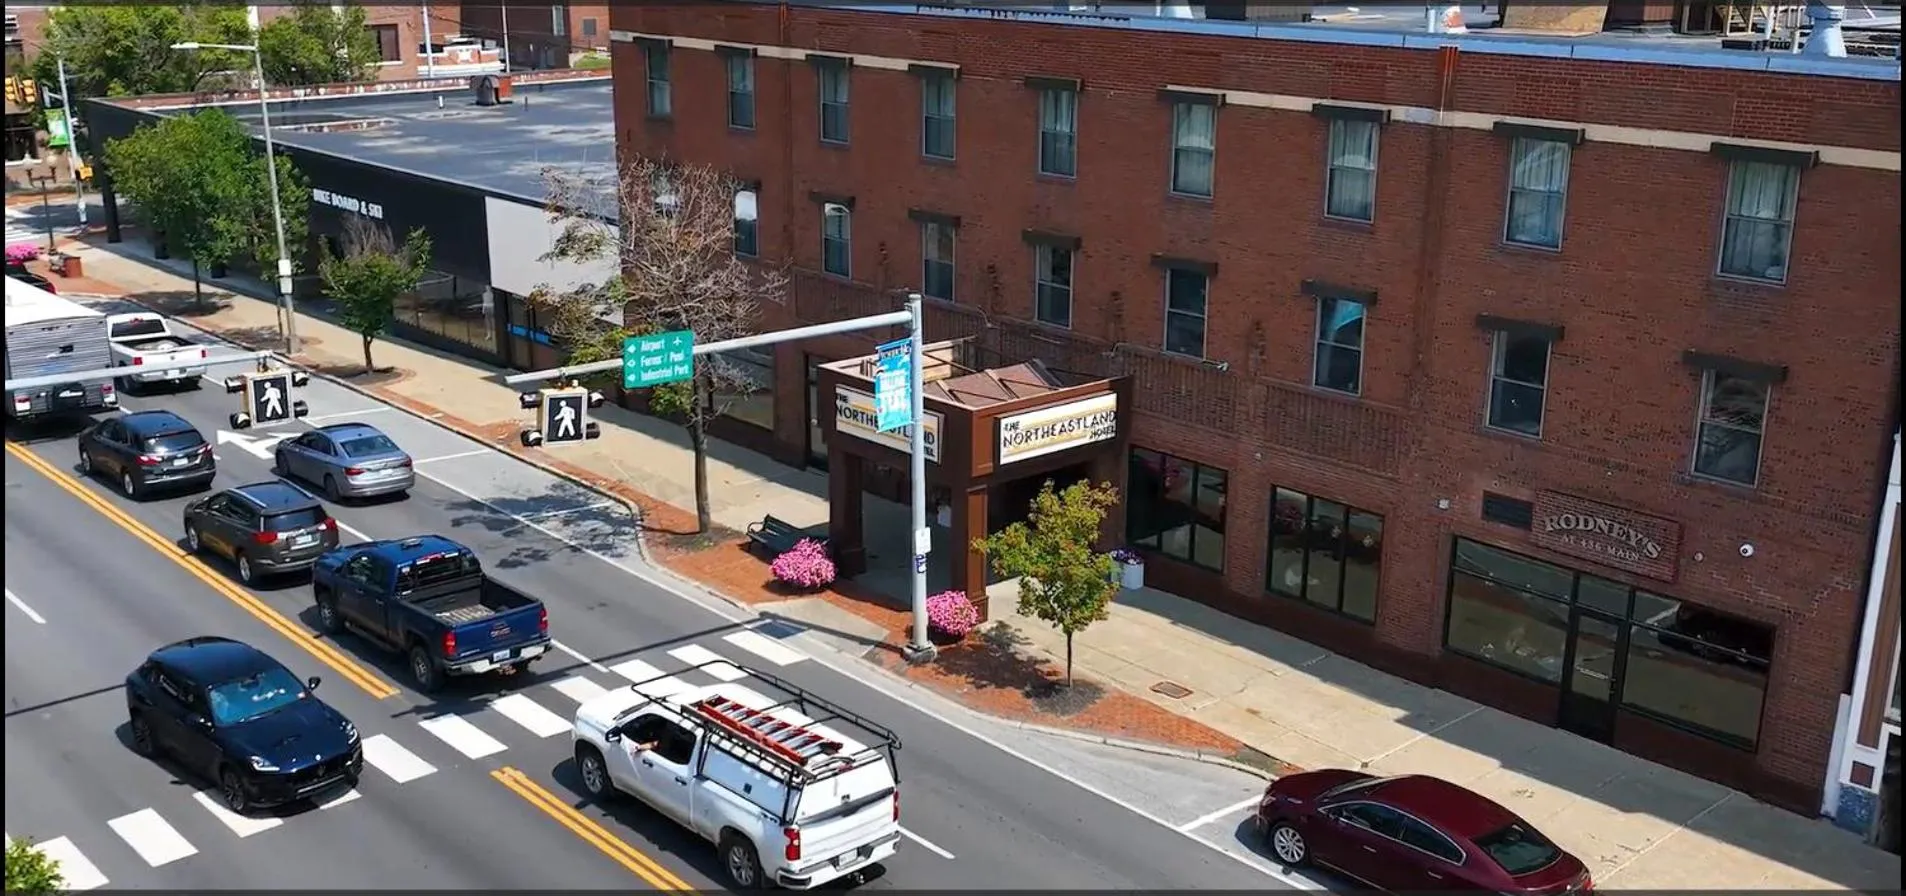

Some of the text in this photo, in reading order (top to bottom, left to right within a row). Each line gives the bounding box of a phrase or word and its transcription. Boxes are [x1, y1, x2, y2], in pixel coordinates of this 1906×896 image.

[360, 201, 368, 216] &
[641, 339, 665, 352] Airport
[641, 364, 689, 381] Industrial Park
[1002, 410, 1118, 448] NORTHEASTLAND
[1004, 421, 1020, 433] THE
[1089, 424, 1118, 440] HOTEL
[1545, 513, 1661, 559] RODNEY'S
[1562, 533, 1576, 545] AT
[1607, 544, 1641, 561] MAIN
